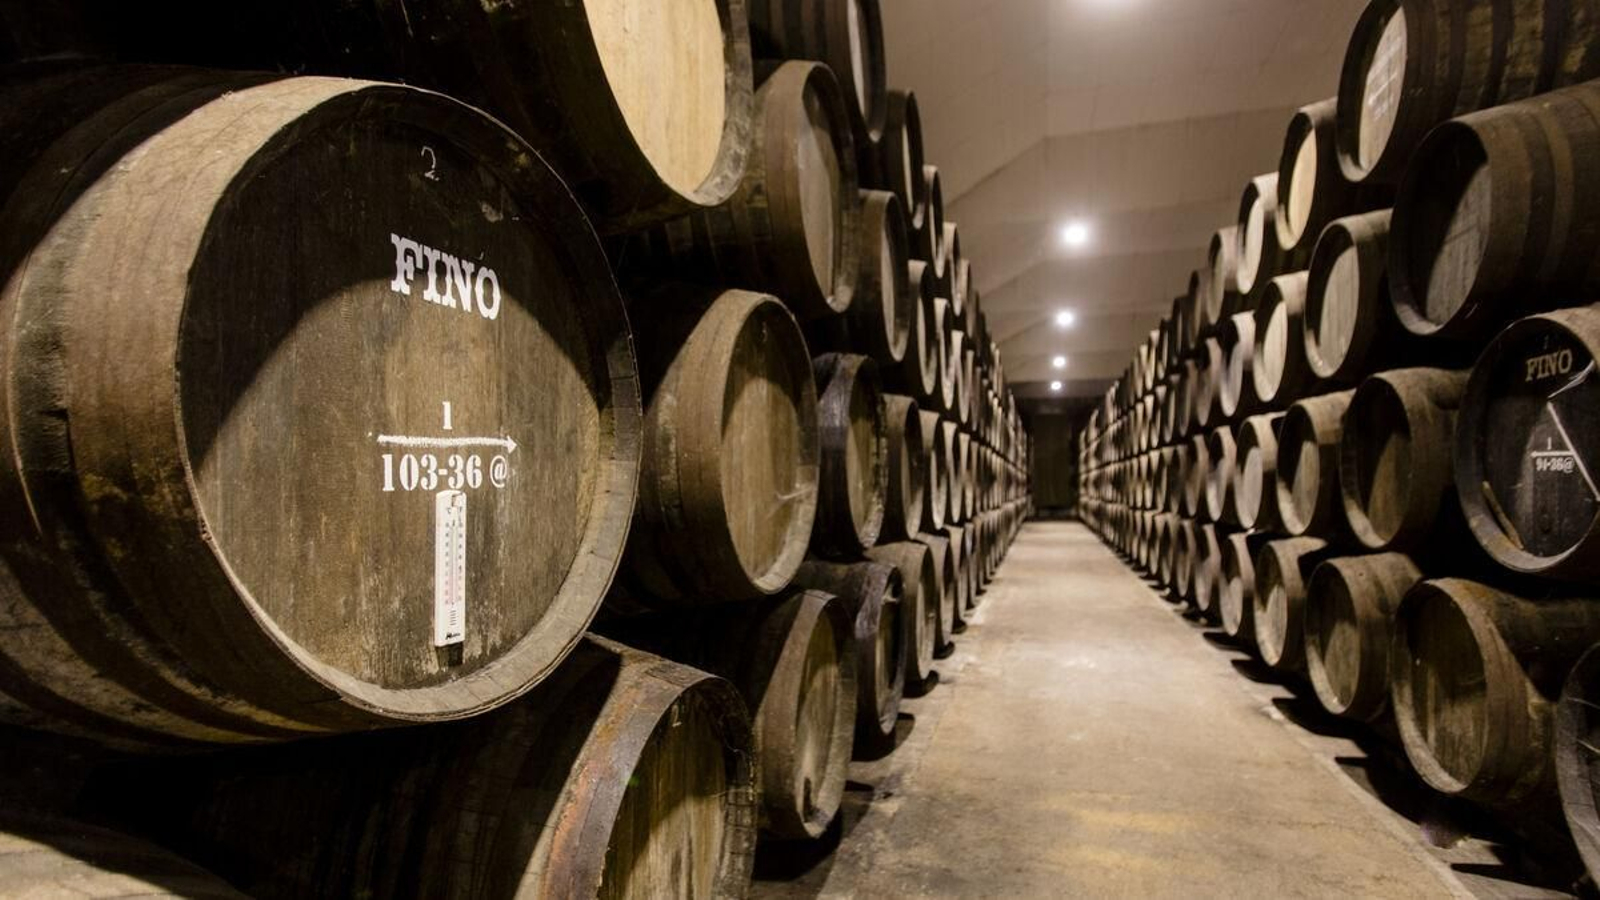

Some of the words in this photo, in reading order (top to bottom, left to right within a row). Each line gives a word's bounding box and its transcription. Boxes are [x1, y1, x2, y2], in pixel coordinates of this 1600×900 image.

[420, 145, 439, 182] 2
[390, 232, 501, 320] FINO
[1524, 348, 1573, 382] FINO
[442, 400, 453, 430] 1
[381, 453, 483, 492] 103-36
[489, 454, 508, 489] @
